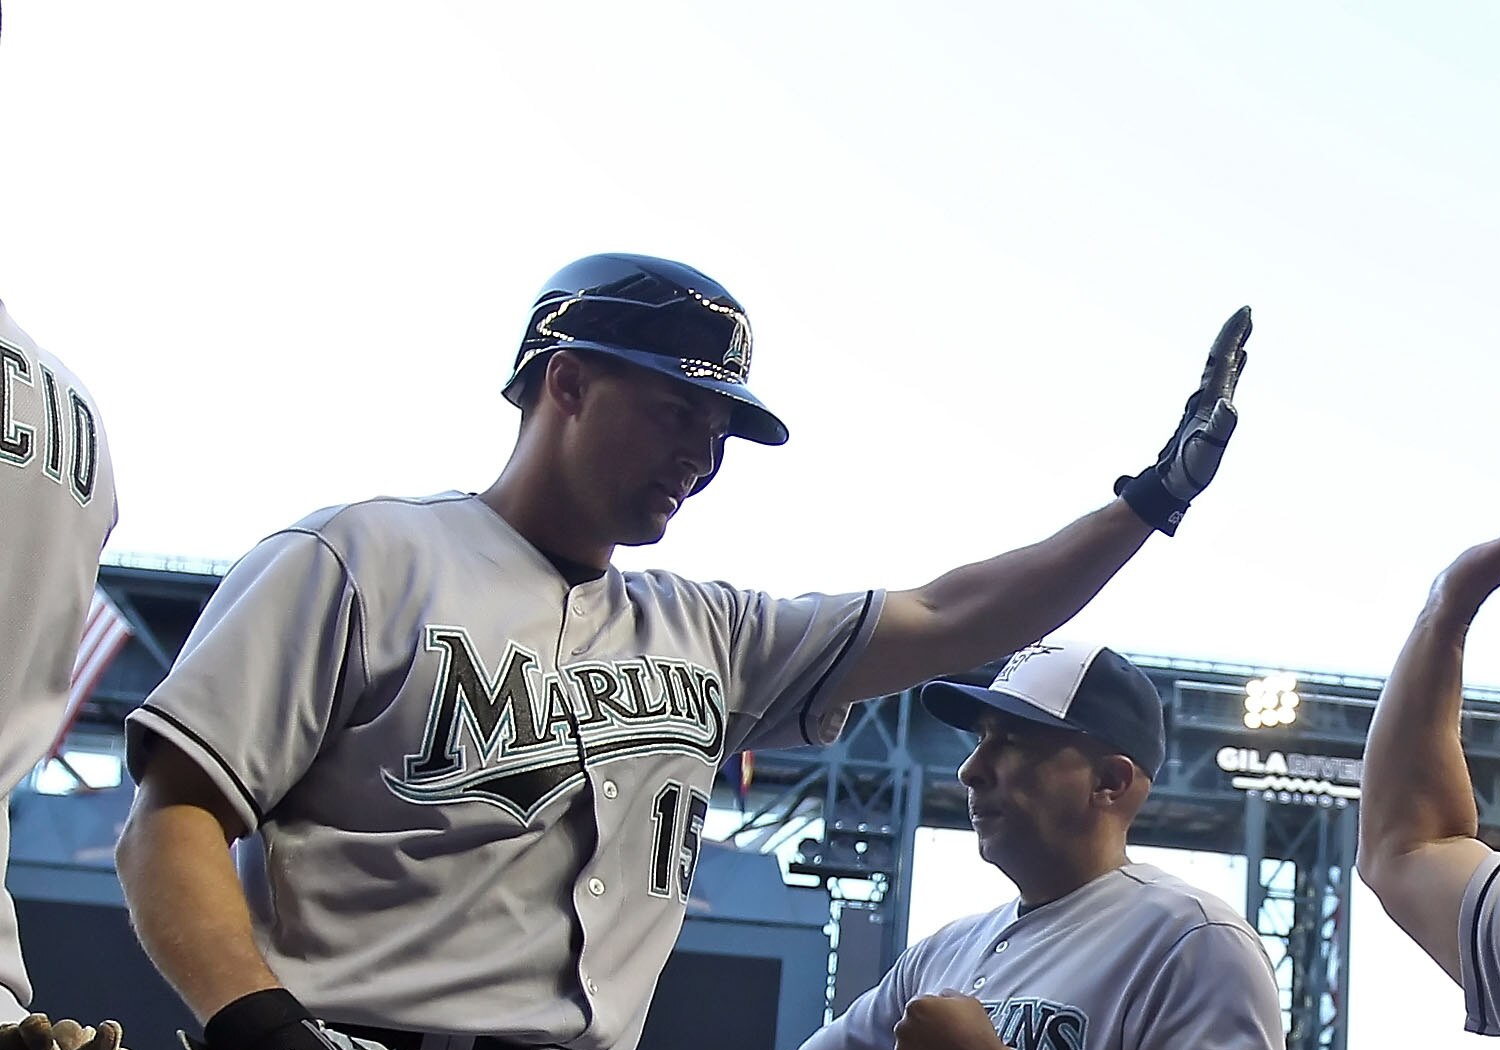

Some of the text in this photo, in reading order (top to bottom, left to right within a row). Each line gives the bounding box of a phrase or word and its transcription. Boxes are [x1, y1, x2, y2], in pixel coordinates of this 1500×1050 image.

[402, 624, 726, 784] MARLINS
[1216, 746, 1364, 784] GILA RIVE
[1246, 789, 1349, 809] CASINOS
